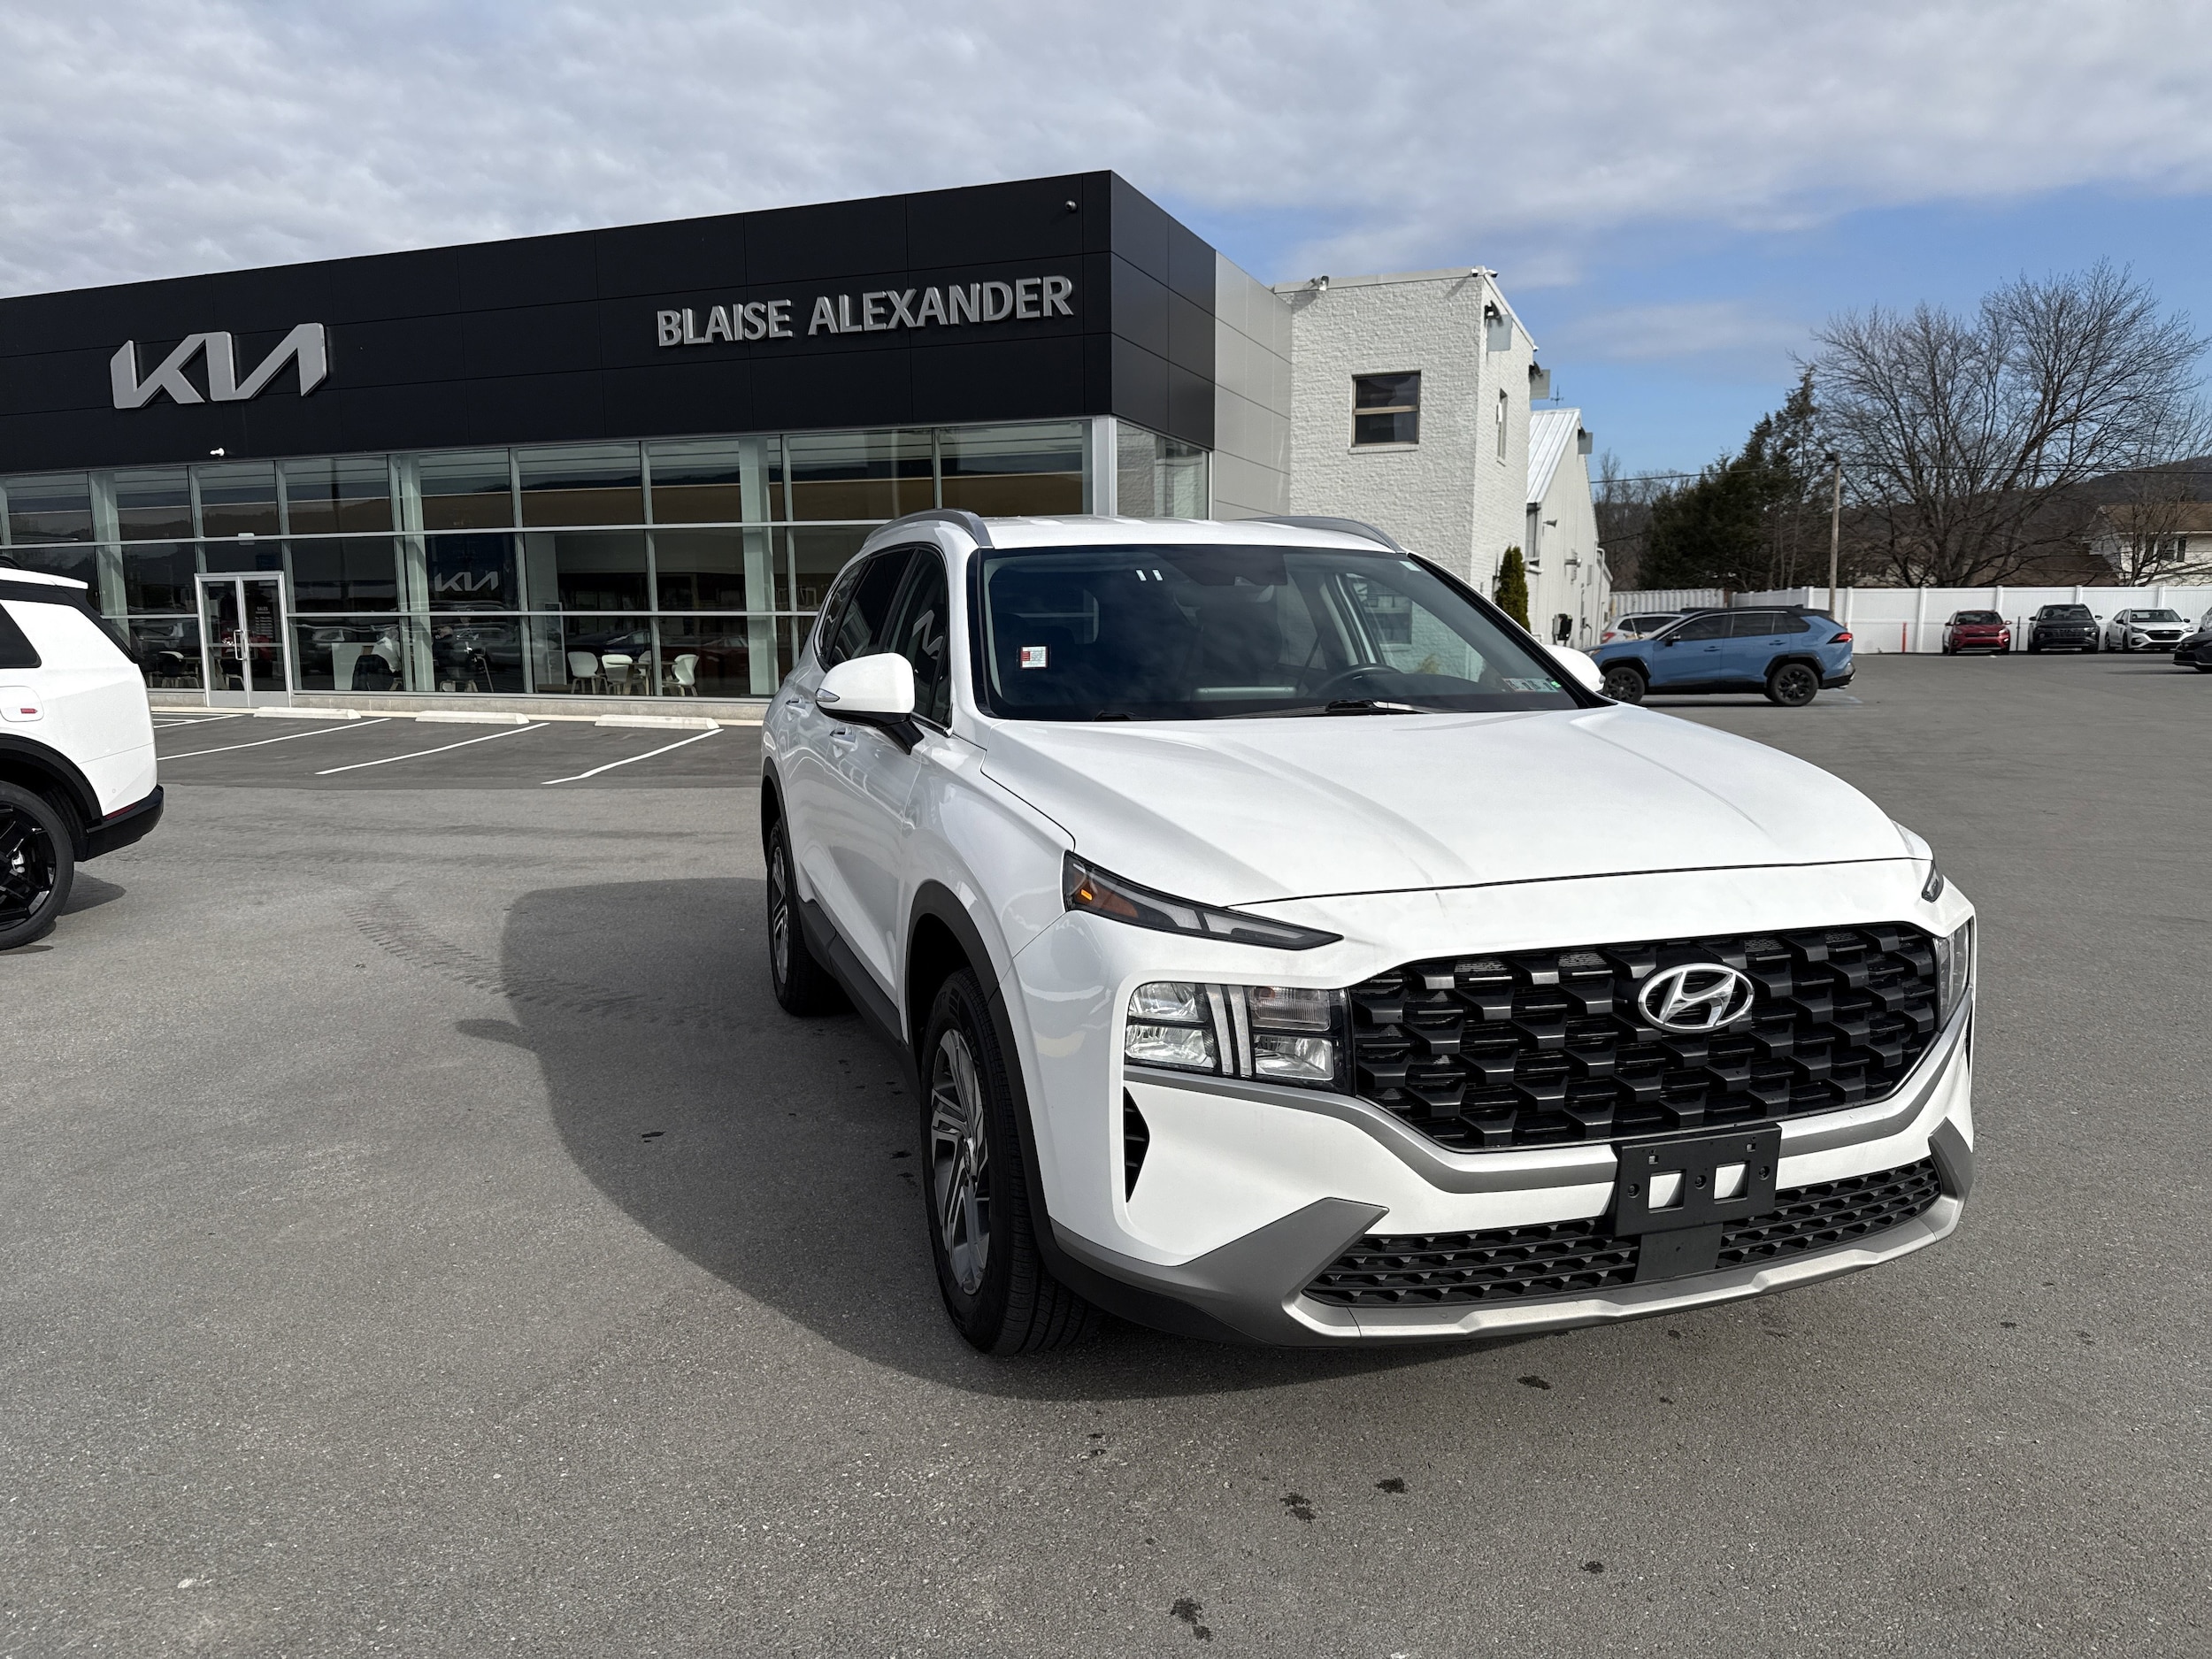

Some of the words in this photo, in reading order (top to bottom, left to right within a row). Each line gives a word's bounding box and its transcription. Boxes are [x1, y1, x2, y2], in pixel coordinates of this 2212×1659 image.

[657, 299, 794, 347] BLAISE
[808, 275, 1075, 335] ALEXANDER
[110, 322, 327, 410] KIA
[434, 571, 499, 592] KIA
